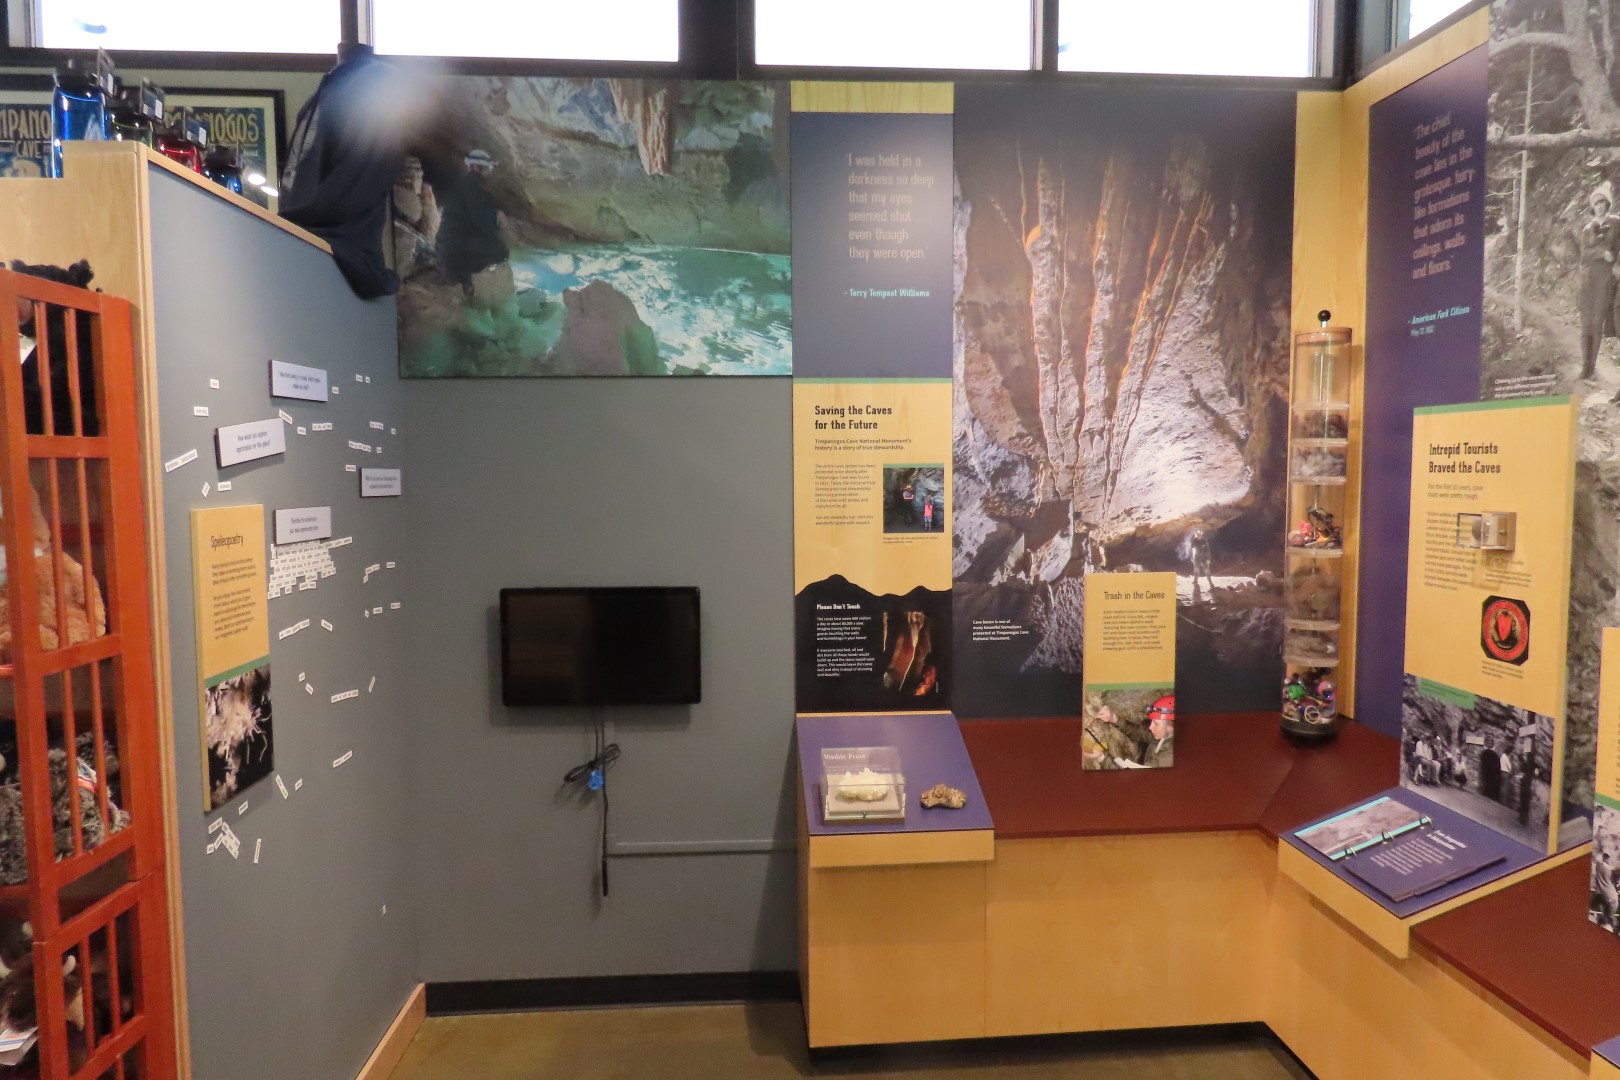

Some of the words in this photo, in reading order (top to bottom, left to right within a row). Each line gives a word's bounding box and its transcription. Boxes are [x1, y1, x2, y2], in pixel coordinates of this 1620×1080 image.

[1415, 140, 1440, 159] beauty
[1451, 128, 1465, 142] the
[856, 157, 875, 167] was
[879, 153, 899, 167] held
[902, 154, 912, 167] in
[915, 157, 922, 167] a
[1415, 164, 1432, 180] cave
[1460, 146, 1473, 161] the
[848, 172, 893, 185] darkness
[896, 175, 908, 185] so
[911, 172, 934, 188] deep
[849, 191, 868, 203] that
[871, 194, 886, 206] my
[890, 194, 912, 206] eyes
[1429, 191, 1469, 215] formations
[848, 210, 887, 222] seemed
[890, 210, 911, 222] shut
[848, 230, 871, 240] even
[875, 228, 909, 244] though
[849, 246, 870, 261] they
[874, 248, 898, 259] were
[1412, 264, 1426, 280] and
[849, 288, 867, 299] Terry
[869, 288, 898, 299] Tempest
[900, 288, 930, 297] Williams
[1412, 314, 1437, 324] American
[1437, 309, 1448, 319] Fork
[1450, 306, 1470, 316] Citizen
[815, 405, 845, 418] Saving
[848, 405, 863, 415] the
[866, 405, 892, 415] Caves
[815, 420, 828, 430] for
[831, 420, 846, 430] the
[848, 419, 878, 430] Future
[1429, 443, 1460, 458] Intrepid
[1463, 442, 1498, 454] Tourists
[1428, 461, 1456, 473] Braved
[1459, 461, 1472, 473] the
[1475, 460, 1501, 473] Caves
[211, 534, 244, 551] Speleopoetry
[1104, 591, 1122, 600] Trash
[1125, 592, 1130, 600] in
[1133, 591, 1144, 600] the
[1145, 590, 1165, 599] Caves
